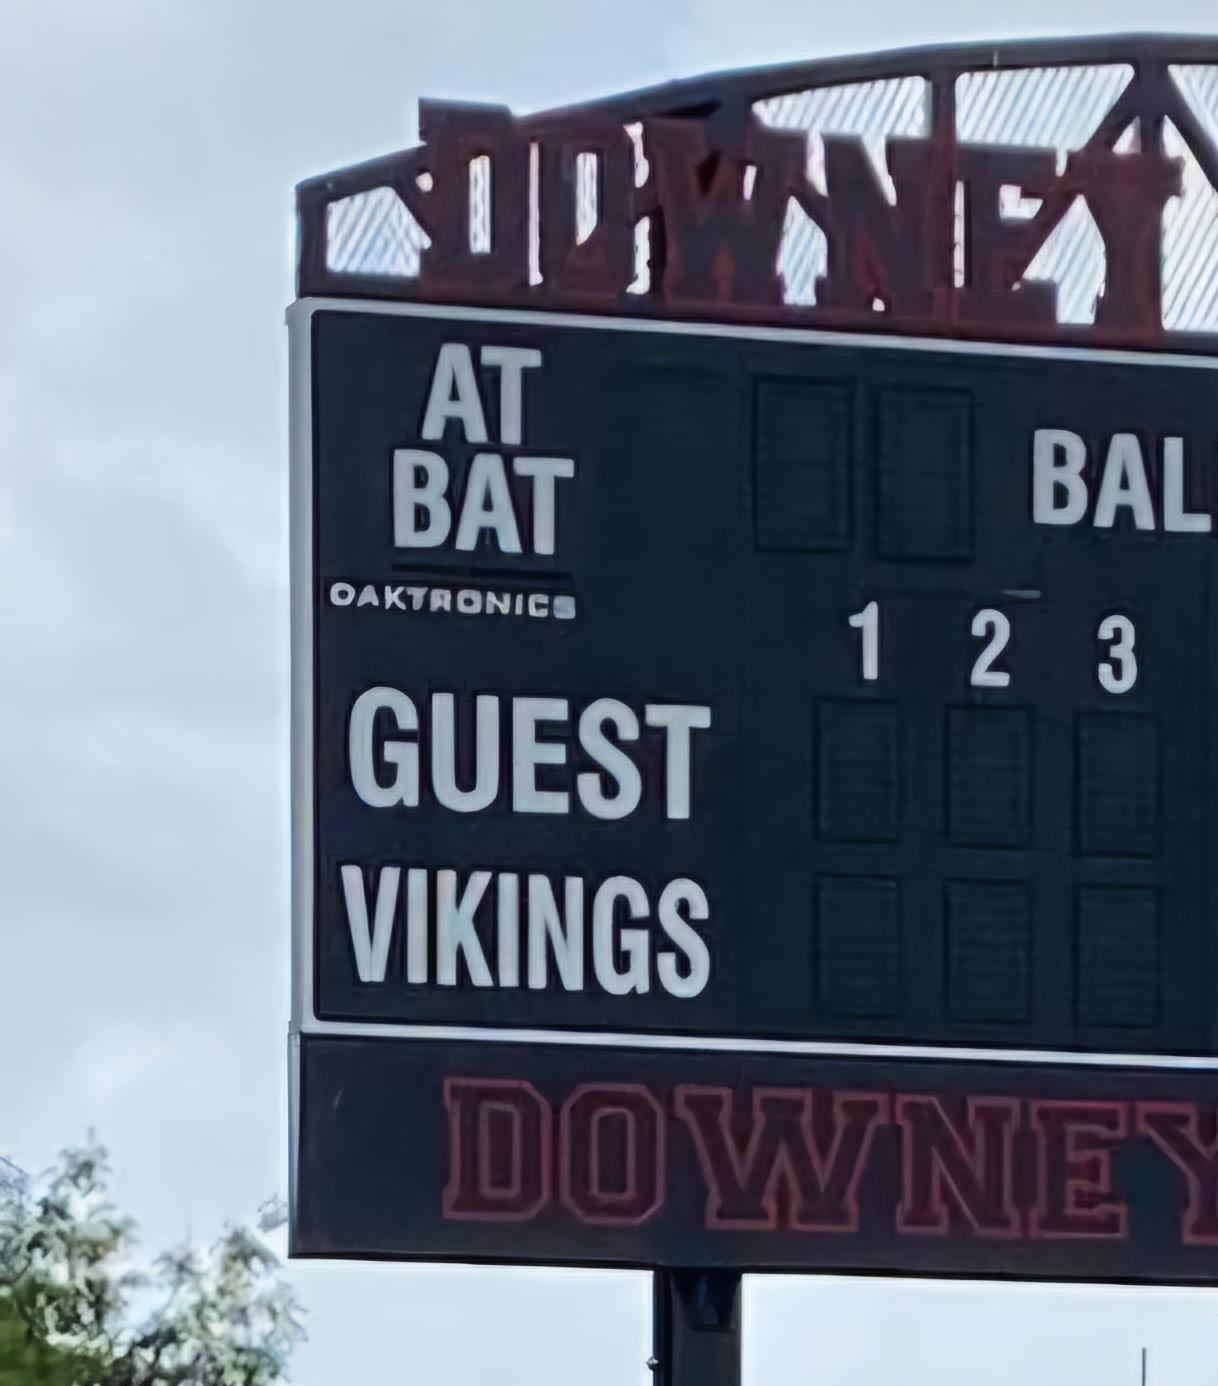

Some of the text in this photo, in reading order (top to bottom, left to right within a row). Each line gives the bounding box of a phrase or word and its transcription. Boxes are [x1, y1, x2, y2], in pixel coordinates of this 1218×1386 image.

[416, 98, 1182, 340] DOWNEY
[421, 342, 543, 448] AT
[392, 448, 576, 556] BAT
[847, 600, 880, 681] 1
[969, 607, 1012, 688] 2
[1096, 613, 1139, 695] 3
[348, 685, 712, 823] GUEST
[339, 863, 711, 999] VIKINGS
